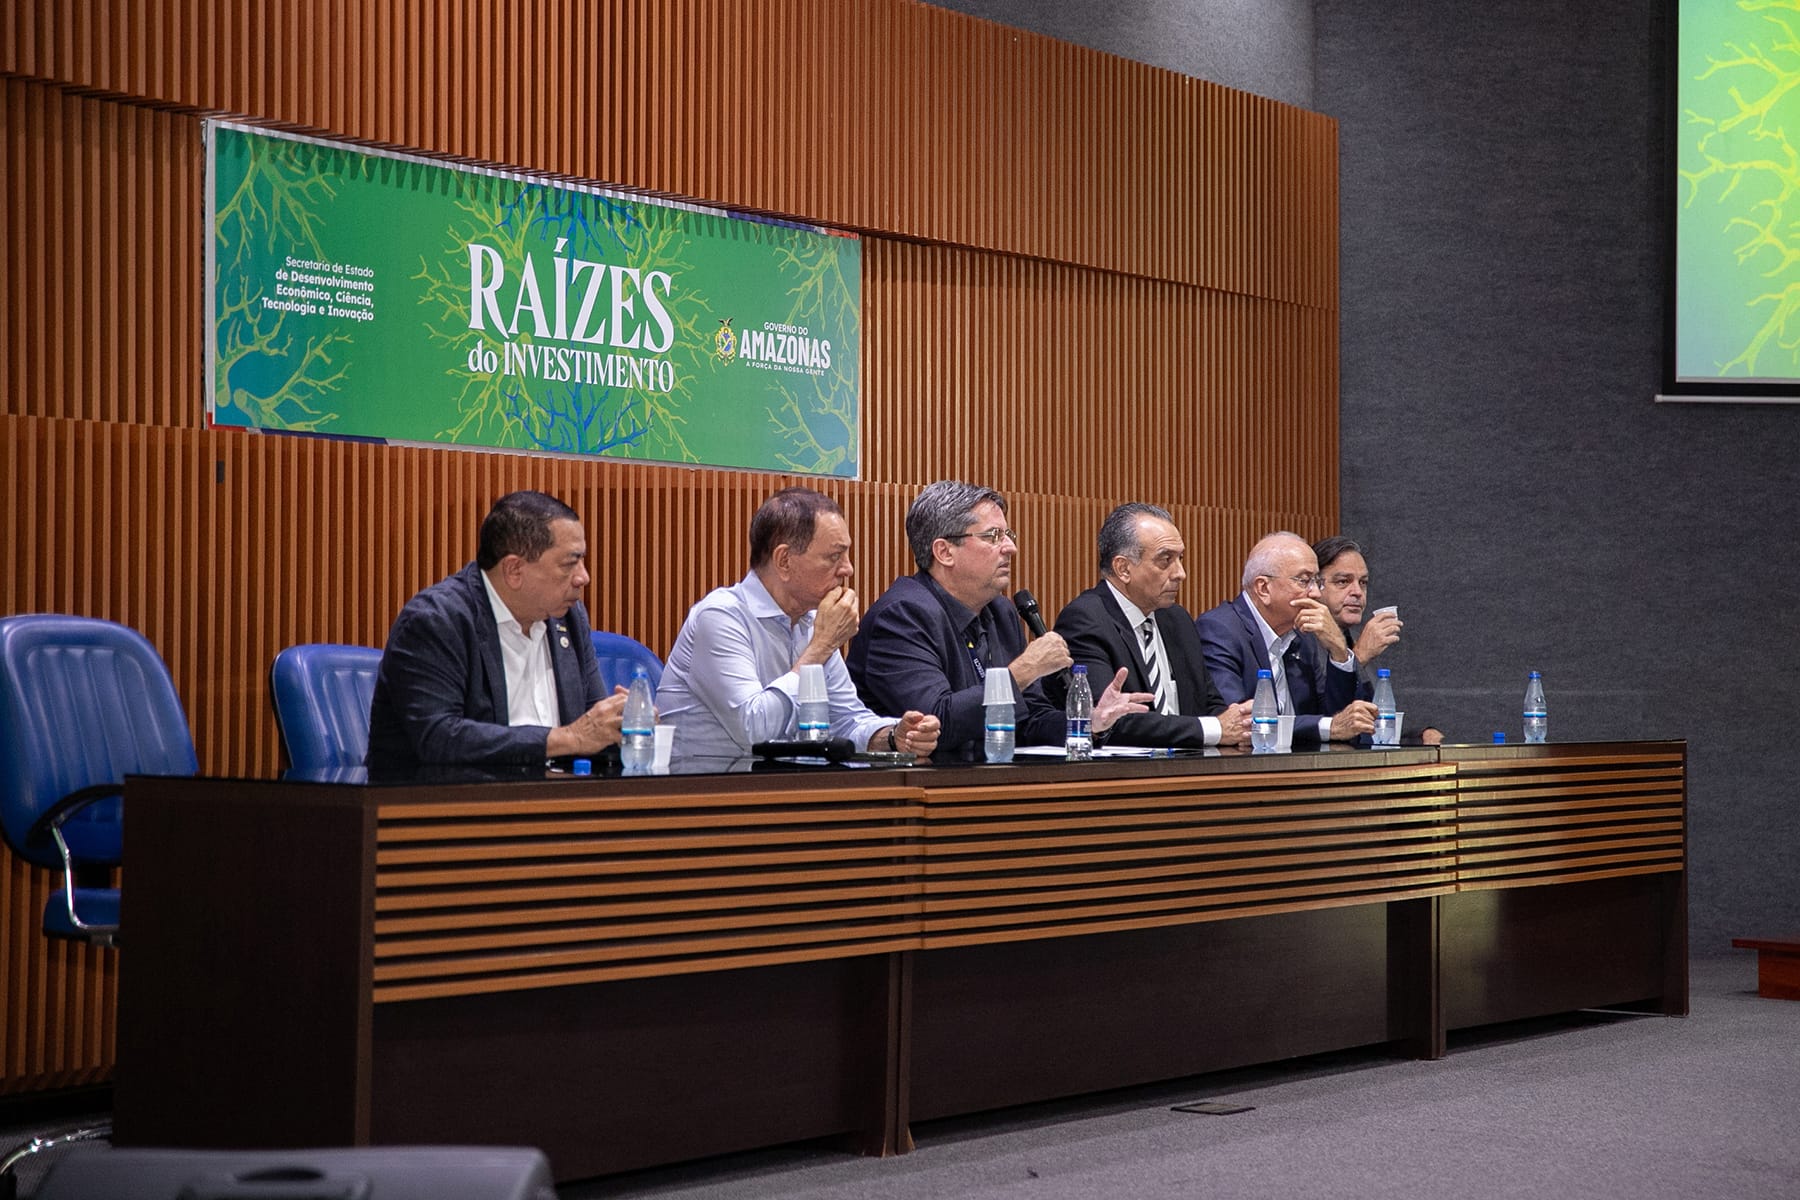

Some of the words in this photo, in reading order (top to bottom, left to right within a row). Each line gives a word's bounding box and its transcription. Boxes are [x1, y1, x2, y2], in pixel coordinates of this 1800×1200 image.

[286, 256, 330, 272] Secretaria
[332, 263, 343, 273] de
[346, 264, 374, 278] Estado
[276, 269, 288, 280] de
[291, 271, 374, 291] Desenvolvimento
[276, 284, 333, 302] Econômico,
[336, 292, 374, 308] Ciência,
[468, 237, 674, 353] RAÍZES
[262, 297, 316, 315] Tecnologia
[319, 306, 325, 314] e
[328, 306, 374, 321] Inovação
[764, 322, 796, 334] GOVERNO
[798, 326, 808, 335] DO
[740, 329, 831, 369] AMAZONAS
[468, 340, 498, 374] do
[504, 341, 674, 393] INVESTIMENTO
[752, 362, 771, 370] FORÇA
